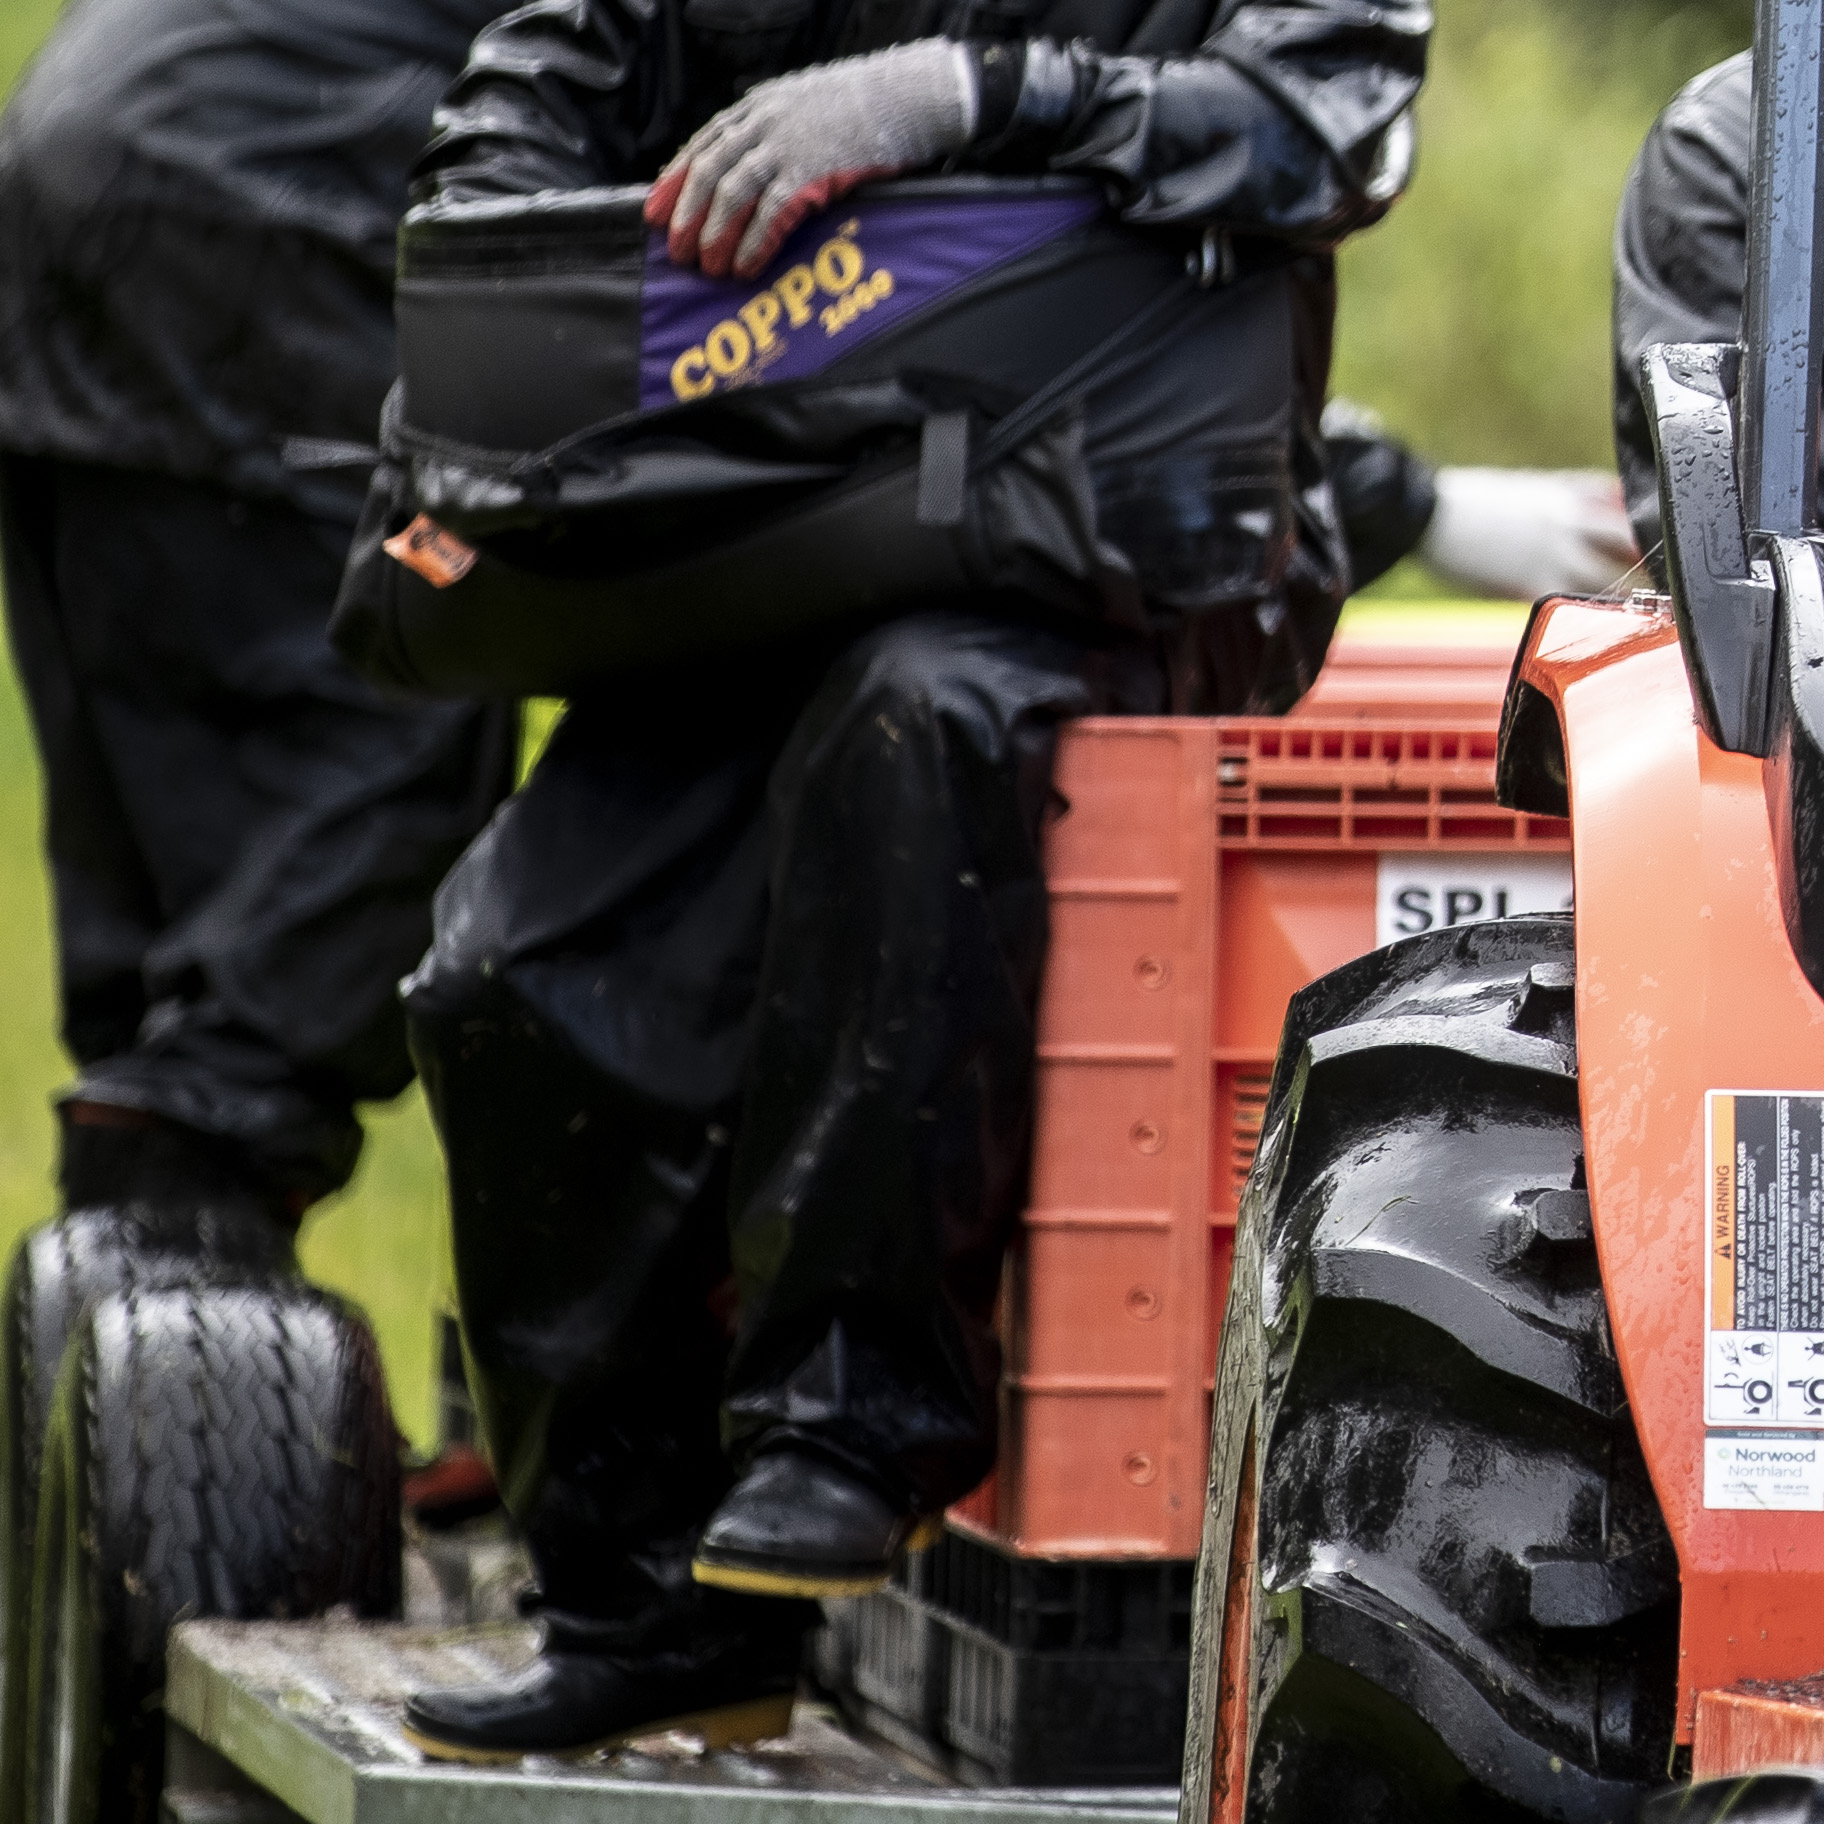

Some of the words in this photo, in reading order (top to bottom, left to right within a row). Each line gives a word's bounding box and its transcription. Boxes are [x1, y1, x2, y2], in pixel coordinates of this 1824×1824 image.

[670, 236, 866, 402] COPPO
[1716, 1165, 1731, 1238] WARNING
[1728, 1465, 1802, 1478] Northland
[1735, 1448, 1816, 1463] Norwood
